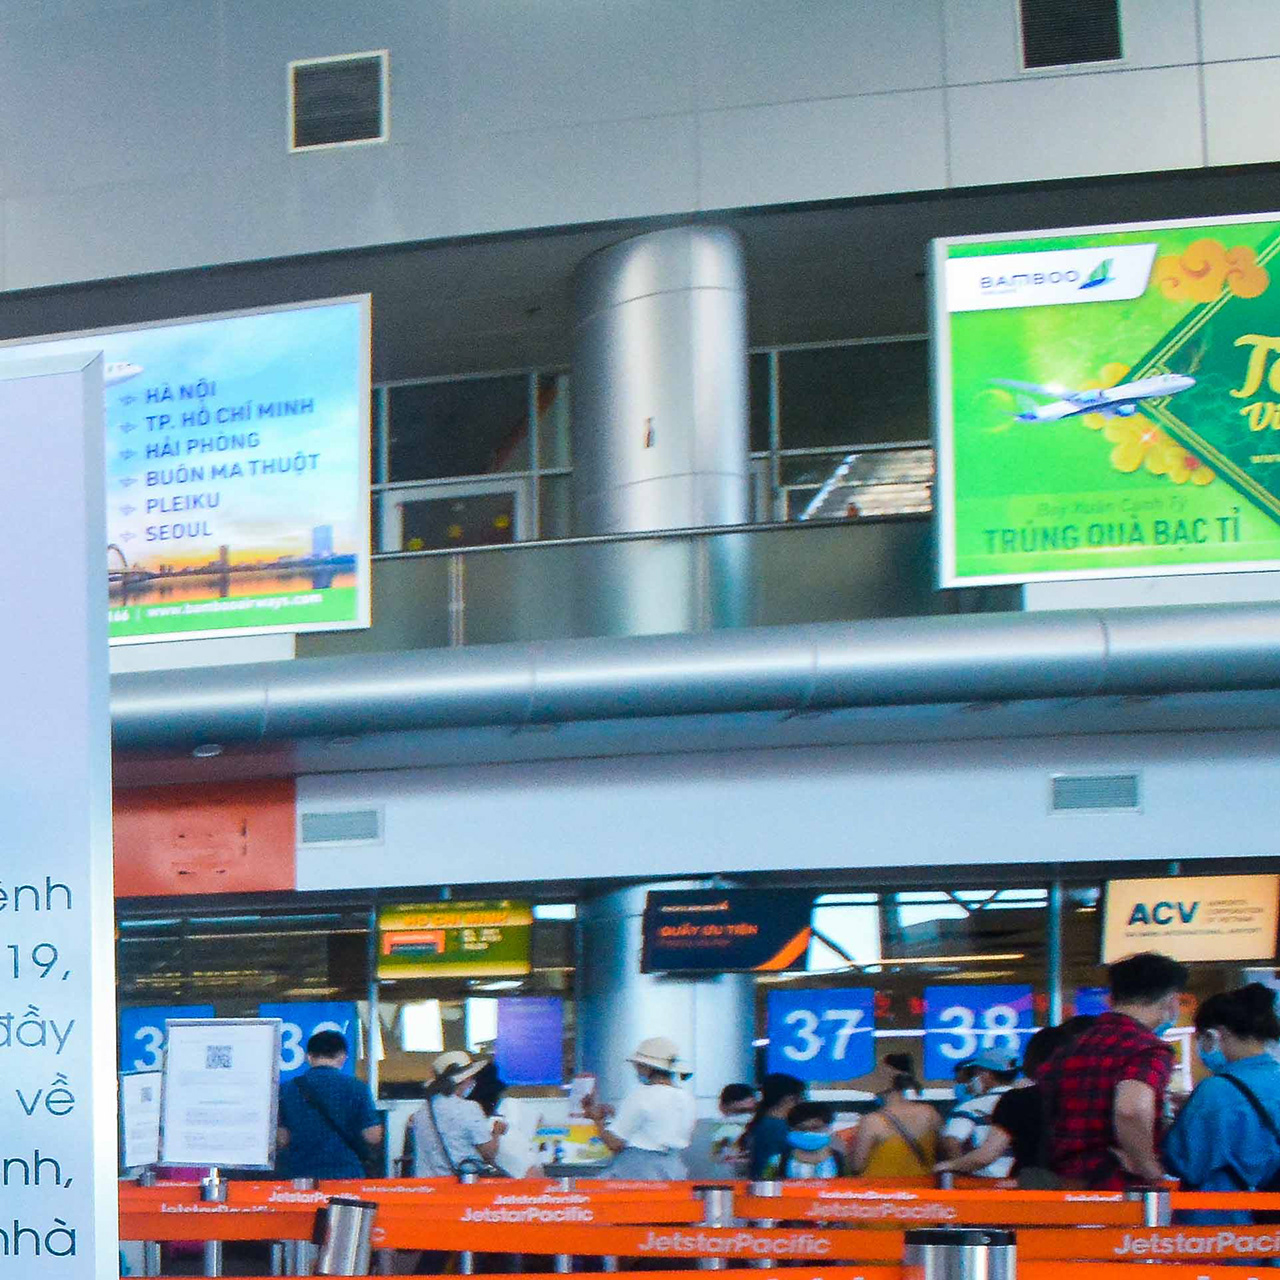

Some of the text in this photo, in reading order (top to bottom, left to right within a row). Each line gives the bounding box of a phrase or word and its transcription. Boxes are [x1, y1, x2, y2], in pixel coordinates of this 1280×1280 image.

[980, 269, 1081, 290] BAMBOO
[146, 415, 176, 432] TP.
[216, 400, 252, 424] CHÍ
[259, 397, 315, 417] MINH
[211, 462, 243, 482] MA
[146, 492, 221, 514] PLEIKU
[146, 521, 213, 542] SEOUL
[1127, 901, 1200, 926] ACV
[782, 1008, 865, 1062] 37
[939, 1006, 1020, 1060] 38
[638, 1230, 831, 1256] JetstarPacific
